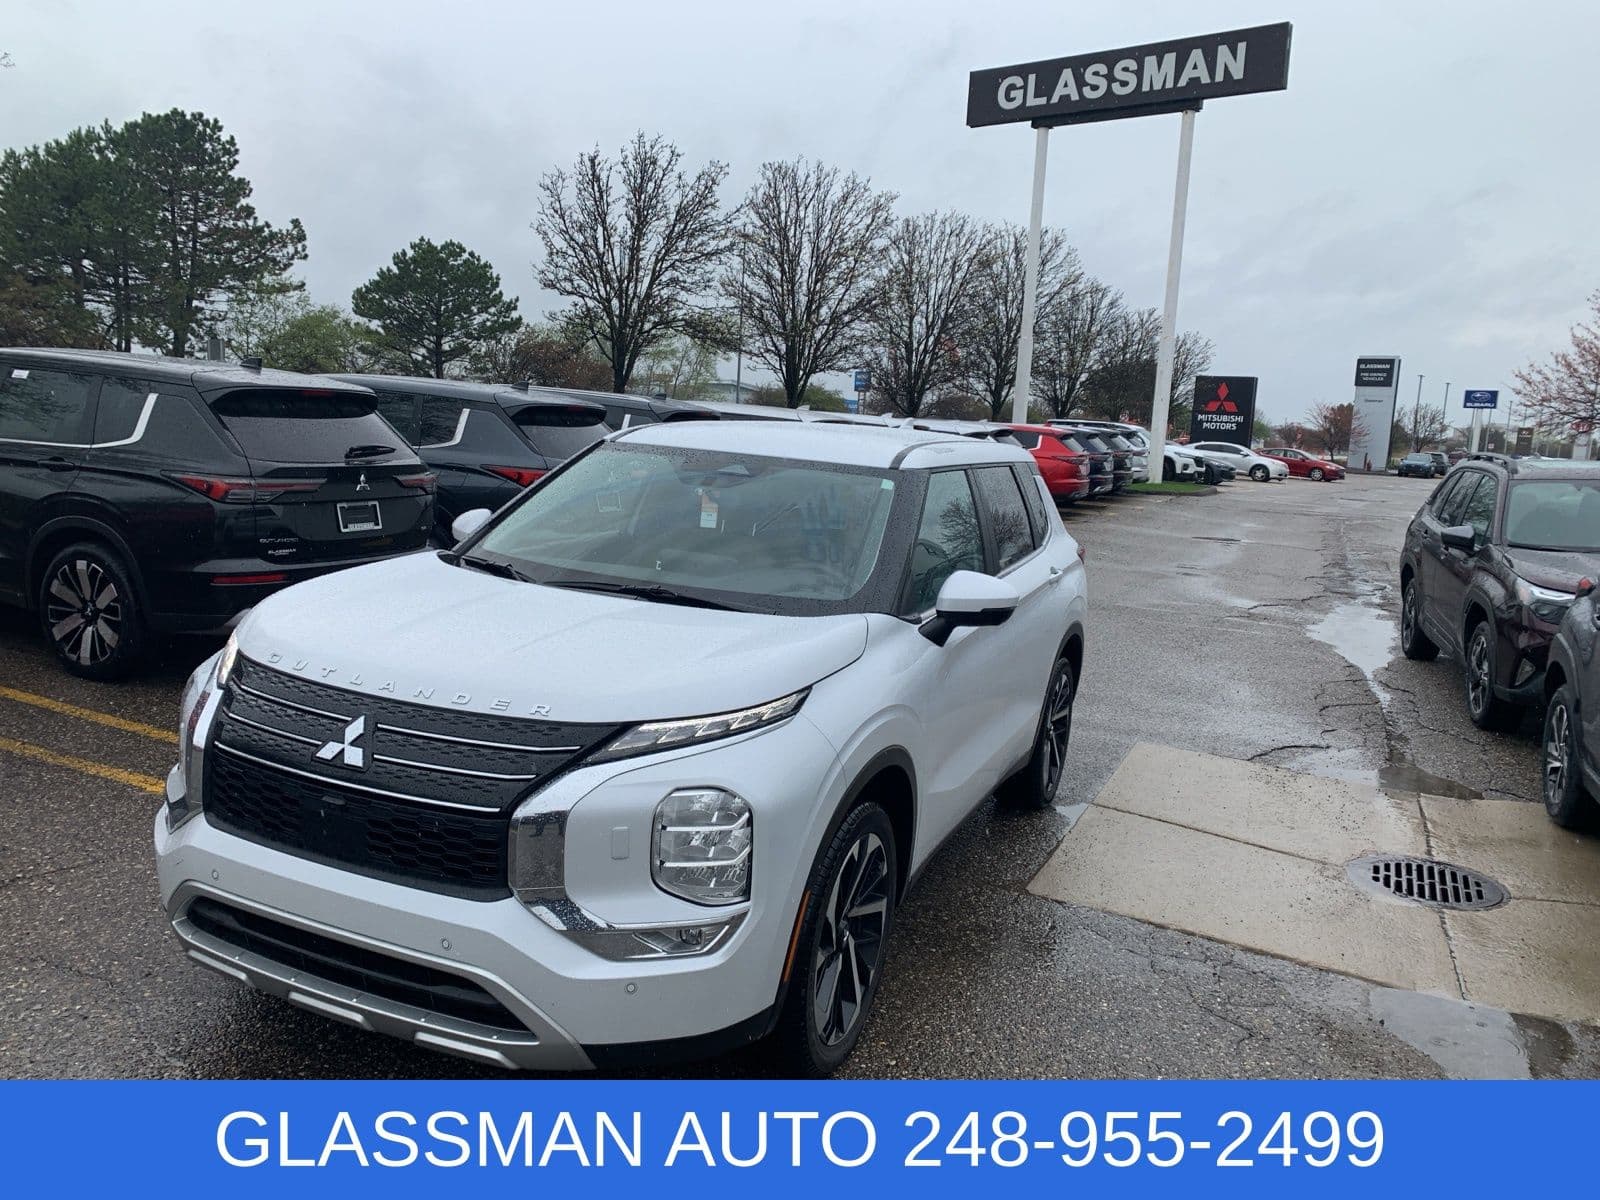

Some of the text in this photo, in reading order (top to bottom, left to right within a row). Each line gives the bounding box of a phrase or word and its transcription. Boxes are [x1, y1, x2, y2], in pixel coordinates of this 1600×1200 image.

[997, 41, 1247, 110] GLASSMAN
[1197, 414, 1244, 423] MITSUBISHI
[1202, 422, 1237, 430] MOTORS
[265, 651, 552, 717] OUTLANDER
